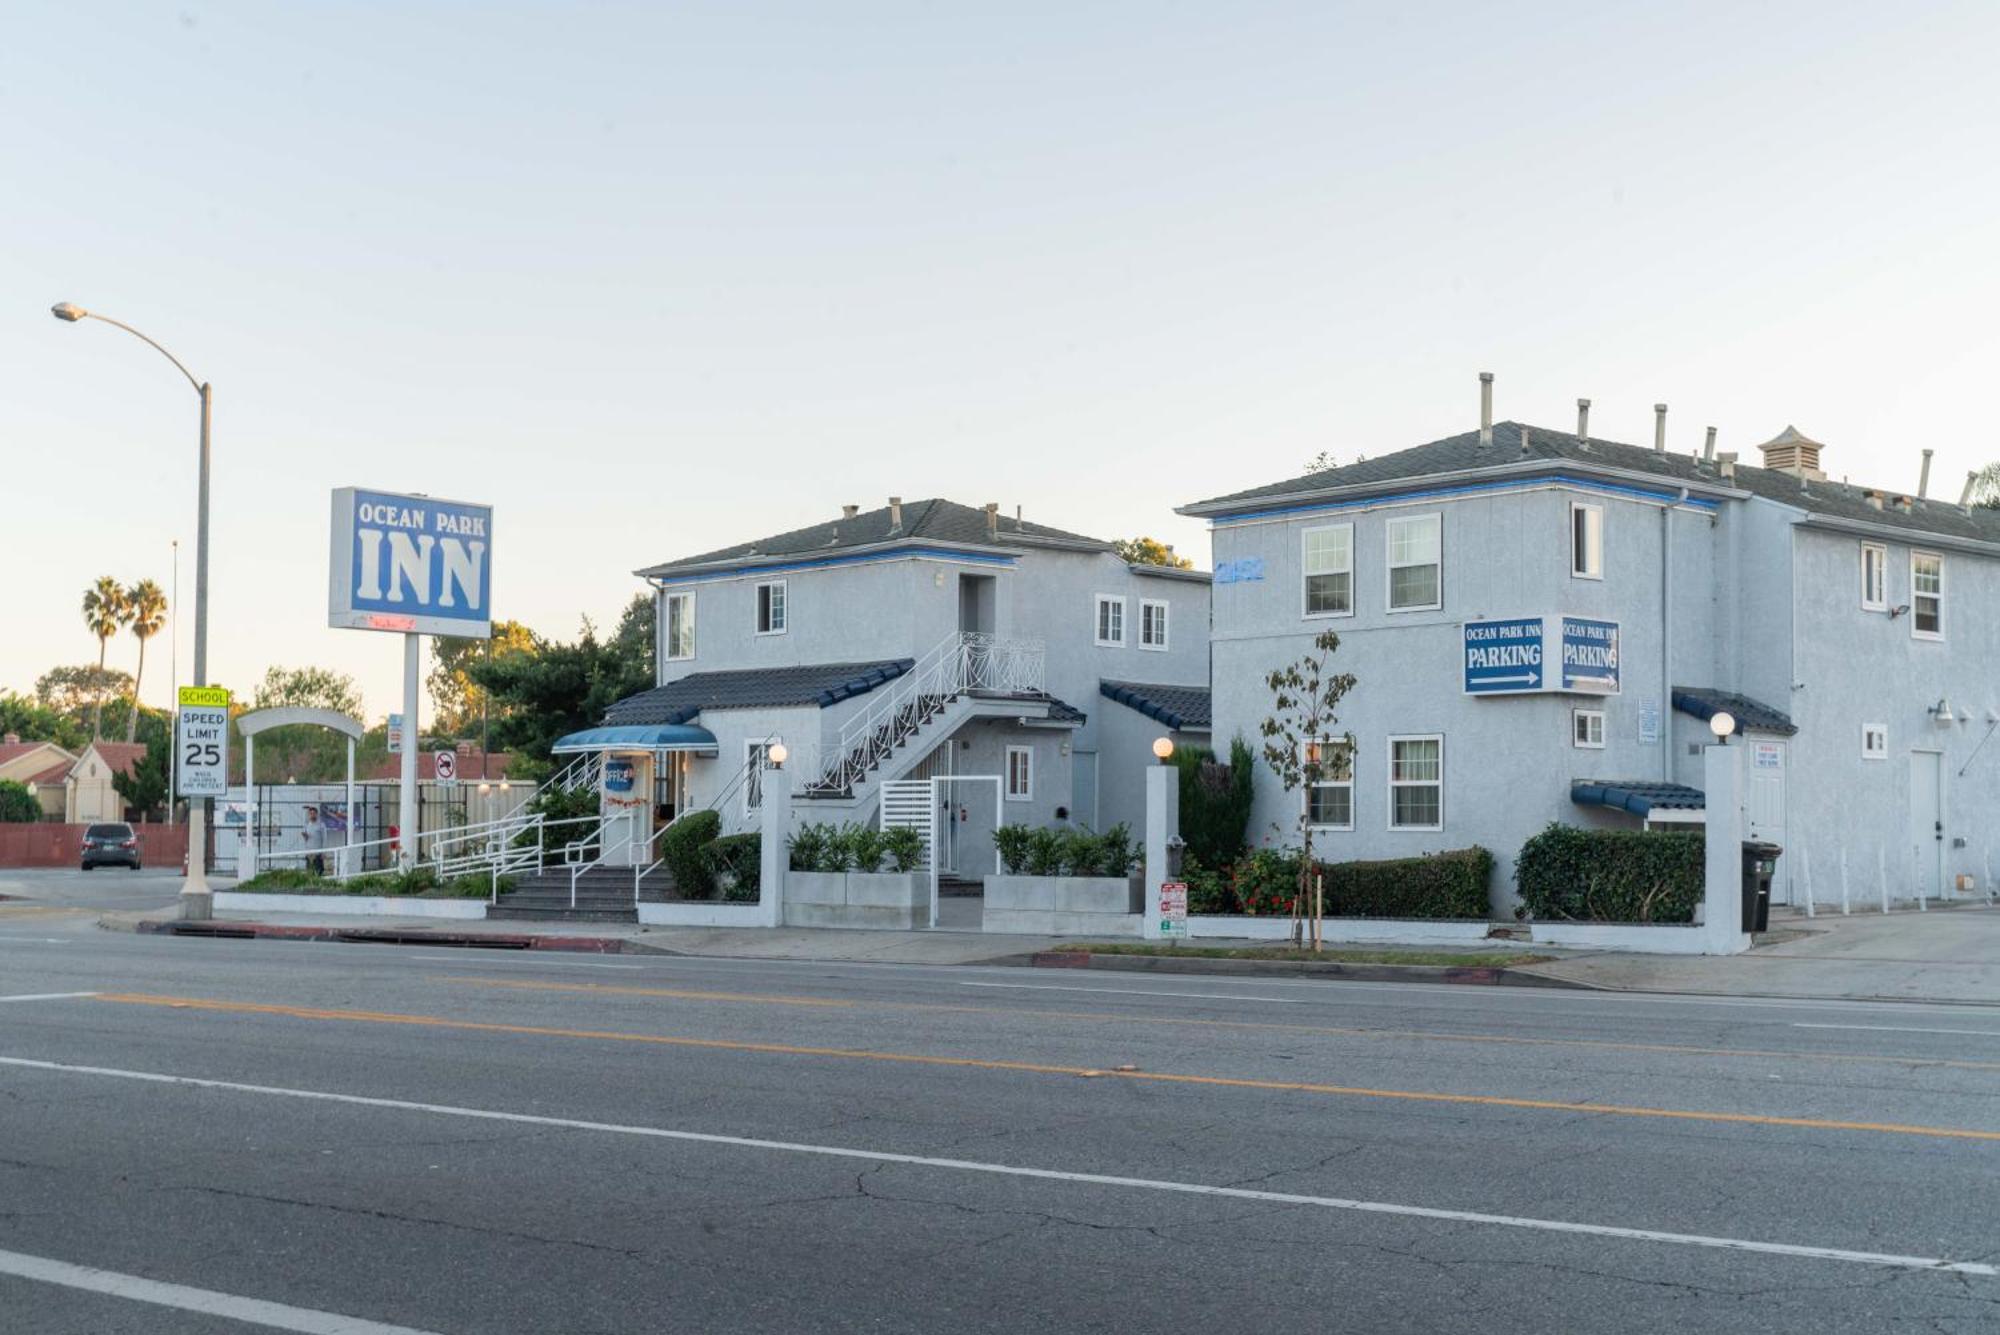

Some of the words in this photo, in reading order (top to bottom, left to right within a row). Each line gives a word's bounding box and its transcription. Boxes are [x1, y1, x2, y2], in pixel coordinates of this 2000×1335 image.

[359, 503, 425, 529] OCEAN
[436, 512, 486, 537] PARK
[357, 528, 486, 610] INN
[1466, 628, 1497, 641] OCEAN
[1500, 625, 1524, 639] PARK
[1525, 624, 1542, 637] INN
[1563, 623, 1586, 637] OCEAN
[1587, 626, 1606, 640] PARK
[1467, 644, 1541, 669] PARKING
[1563, 643, 1617, 669] PARKING
[182, 691, 226, 704] SCHOOL
[183, 713, 225, 725] SPEED
[187, 728, 219, 740] LIMIT
[185, 744, 221, 766] 25
